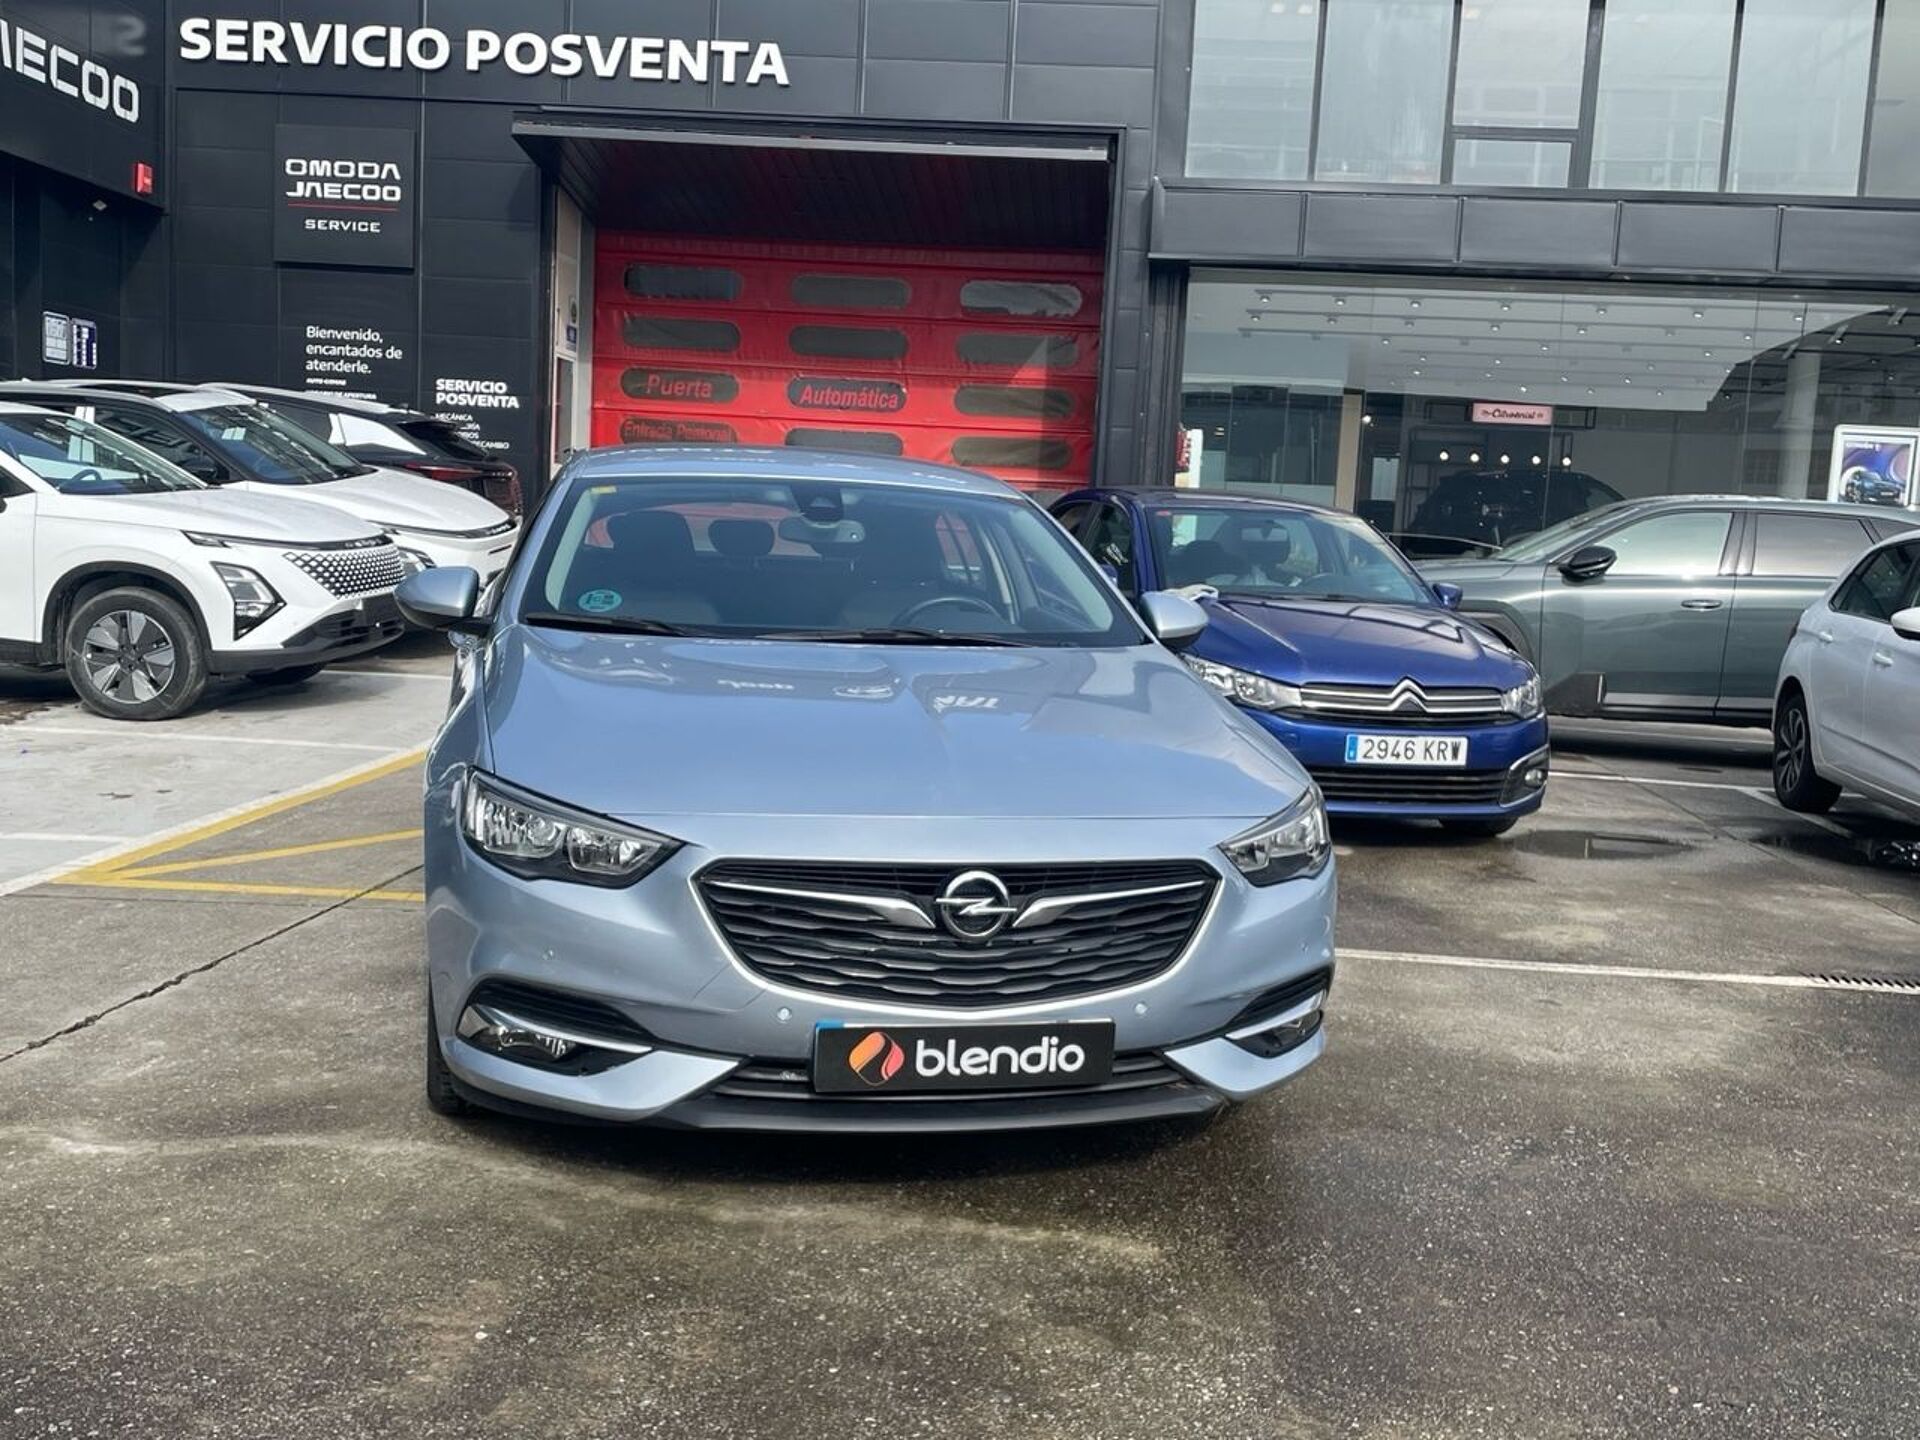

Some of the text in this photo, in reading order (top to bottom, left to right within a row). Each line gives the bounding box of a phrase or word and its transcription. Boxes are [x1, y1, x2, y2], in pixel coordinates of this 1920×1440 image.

[179, 18, 450, 70] SERVICIO
[465, 29, 790, 86] POSVENTA
[285, 158, 401, 180] OMODA
[285, 181, 401, 201] JAECOO
[304, 219, 381, 233] SERVICE
[305, 325, 383, 344] Bienvenido,
[305, 344, 403, 360] encantados de
[305, 359, 372, 374] atenderle.
[436, 378, 507, 394] SERVICIO
[645, 373, 713, 398] Puerta
[436, 392, 520, 409] POSVENTA
[800, 383, 899, 410] Automática
[1362, 738, 1461, 761] 2946 KRW
[915, 1036, 1086, 1077] blendio
